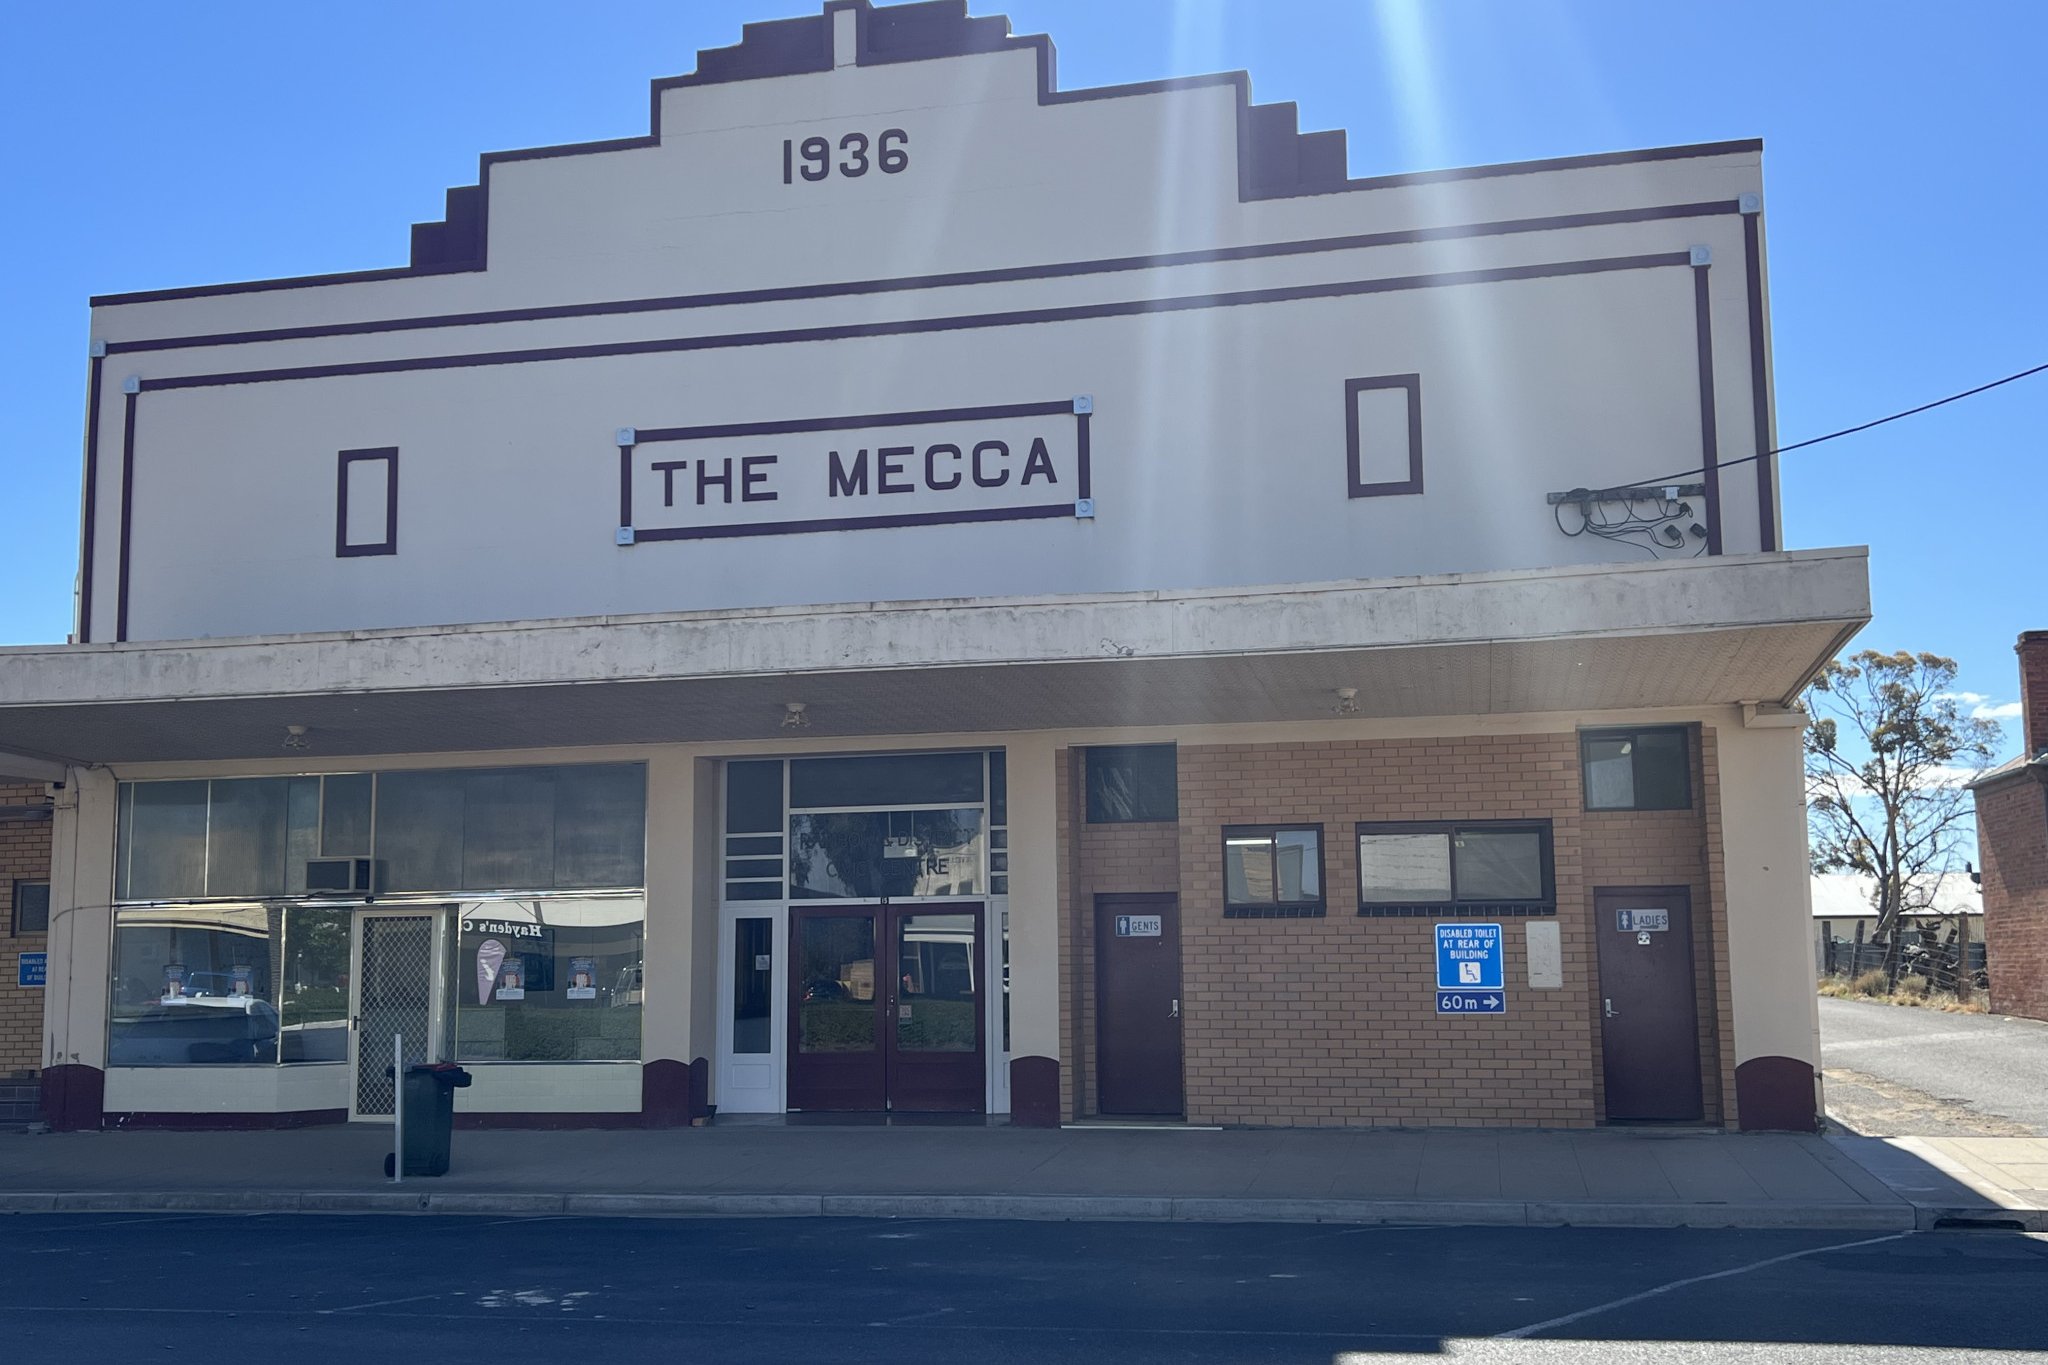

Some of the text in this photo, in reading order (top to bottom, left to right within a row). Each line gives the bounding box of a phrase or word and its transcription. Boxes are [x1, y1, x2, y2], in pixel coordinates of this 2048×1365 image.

[783, 128, 909, 184] 1936
[651, 437, 1058, 507] THE MECCA
[1633, 914, 1667, 925] LADIES
[1131, 921, 1159, 931] GENTS
[1440, 929, 1496, 938] DISABLED TOILET
[1443, 940, 1494, 949] AT REAR OF
[1450, 950, 1488, 959] BUILDING
